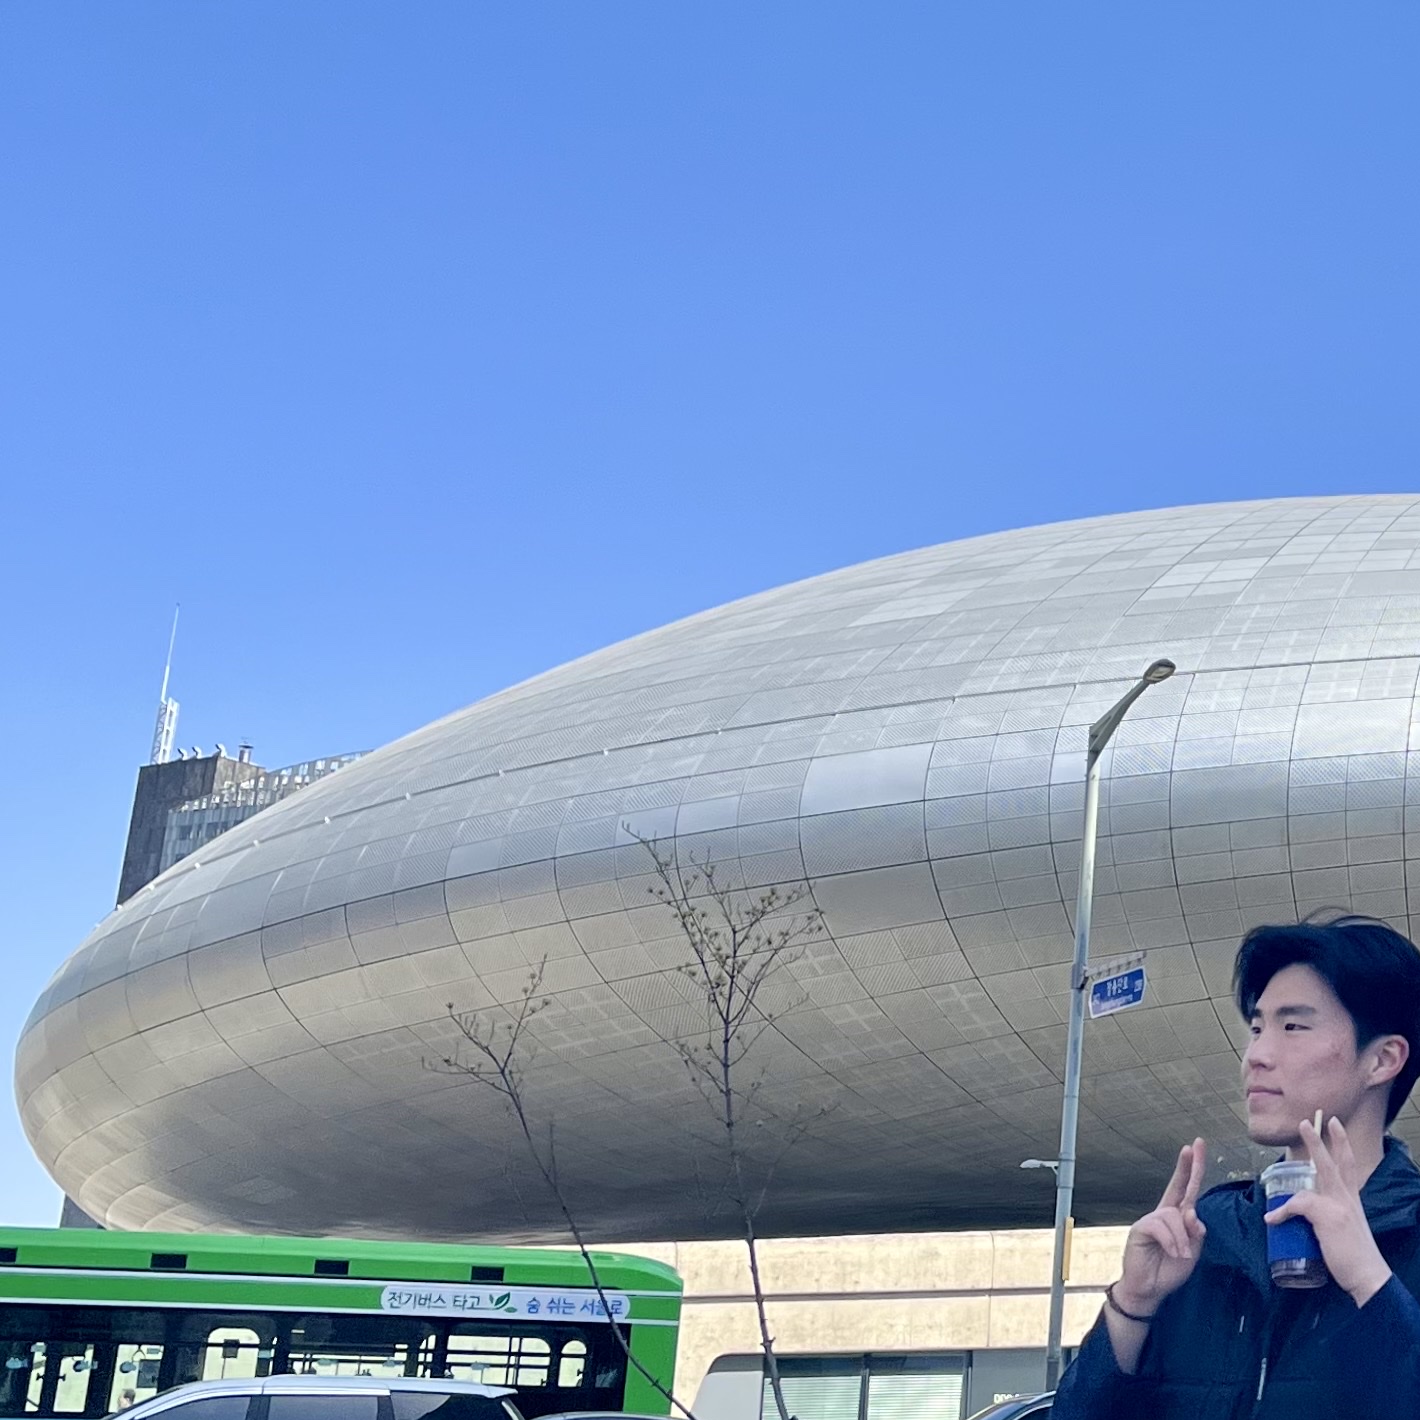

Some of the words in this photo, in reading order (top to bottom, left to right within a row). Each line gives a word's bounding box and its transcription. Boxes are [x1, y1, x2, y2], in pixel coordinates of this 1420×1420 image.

[387, 1291, 447, 1310] 전기버스
[453, 1294, 481, 1311] 타고
[526, 1299, 541, 1314] 숨
[546, 1299, 576, 1316] 쉬는
[580, 1299, 623, 1316] 서울로
